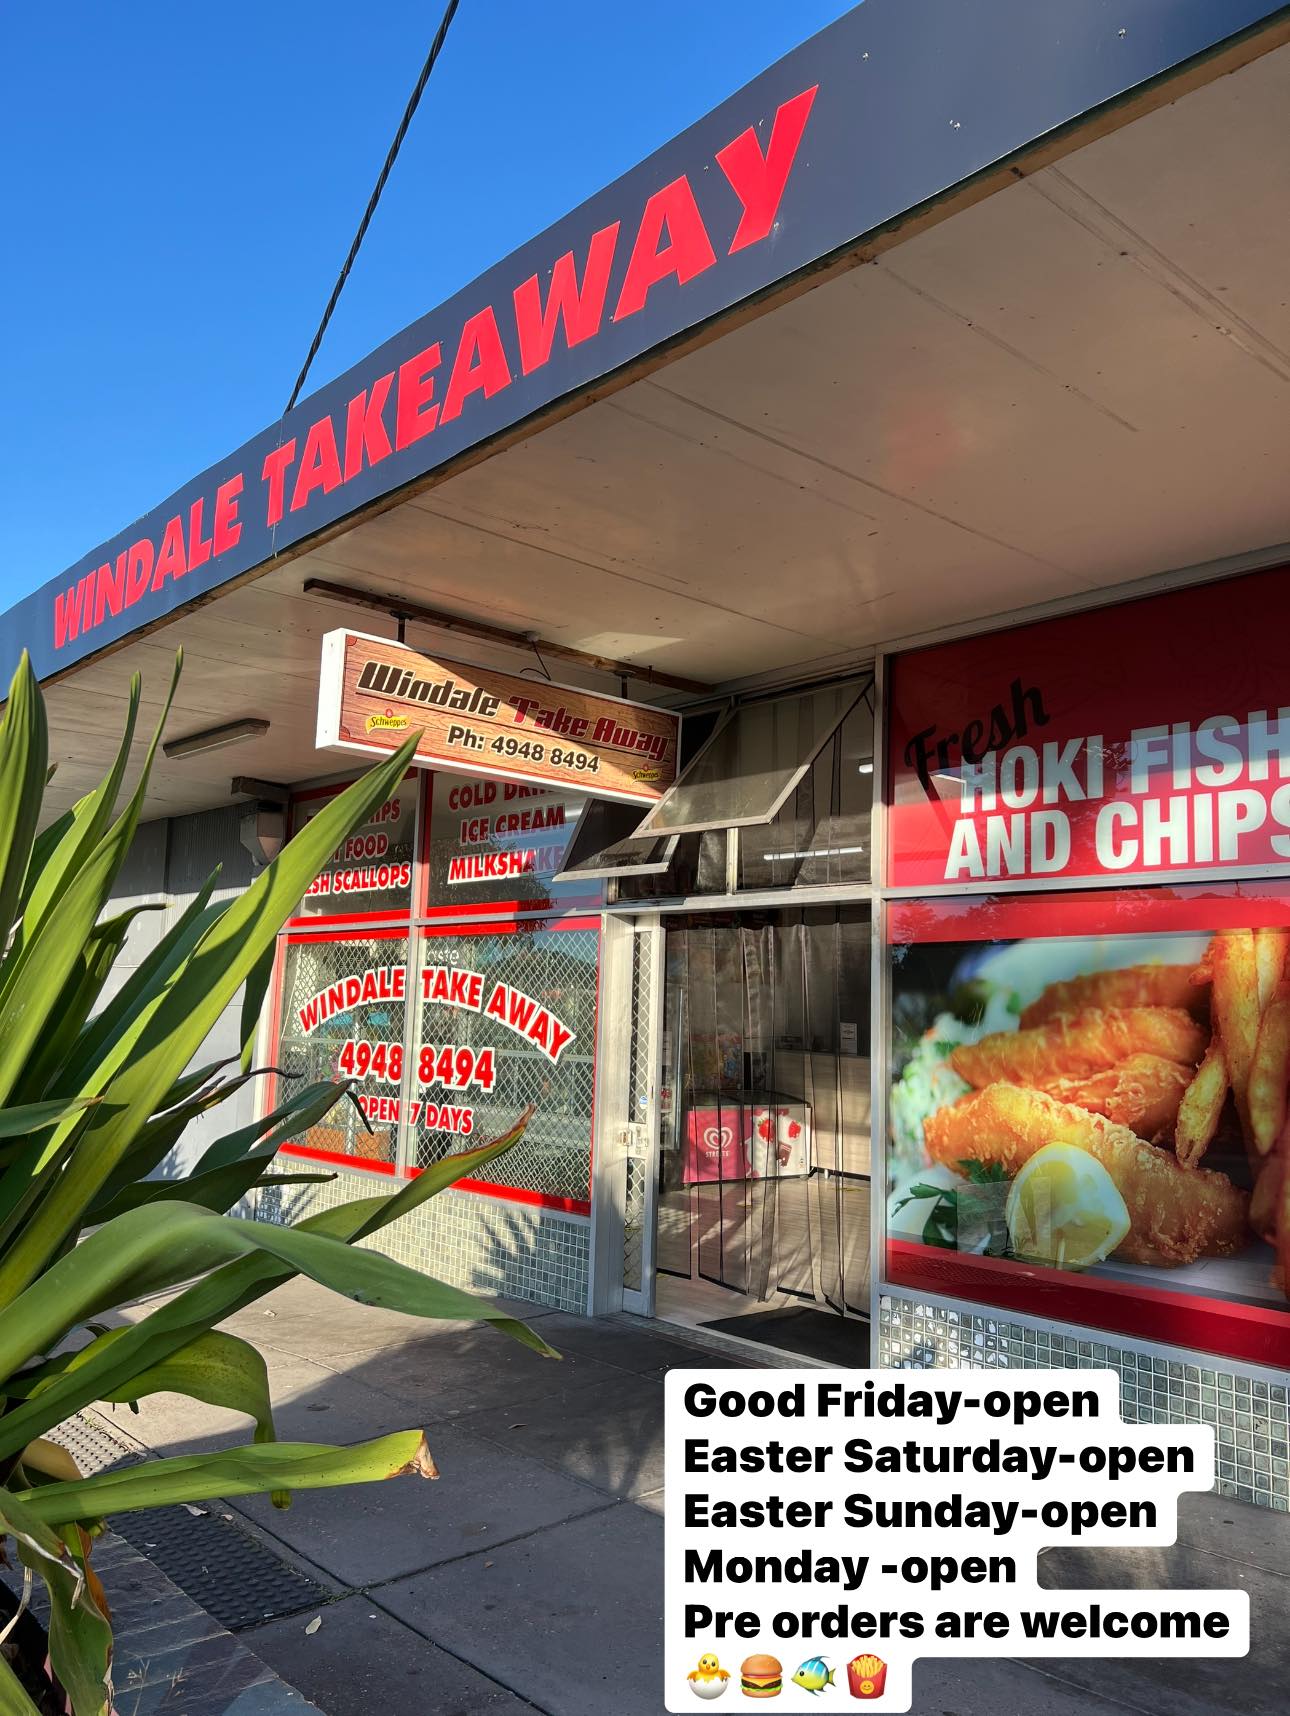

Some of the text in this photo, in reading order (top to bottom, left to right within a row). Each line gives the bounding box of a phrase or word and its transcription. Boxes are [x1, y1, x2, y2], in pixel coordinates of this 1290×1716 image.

[55, 85, 819, 648] WINDALE TAKEAWAY
[356, 661, 668, 761] Windale Take Away
[370, 717, 407, 728] Schweppes
[904, 677, 1050, 790] Fresh
[447, 724, 601, 773] Ph: 4948 8494
[960, 707, 1290, 814] HOKI FISH
[449, 782, 497, 810] COLD
[344, 833, 388, 861] FOOD
[460, 804, 565, 845] ICE CREAM
[944, 810, 1071, 879] AND
[333, 862, 411, 894] SCALLOPS
[298, 966, 577, 1064] WINDALE TAKE AWAY
[338, 1039, 496, 1092] 4948 8494
[357, 1095, 474, 1135] OPEN 7 DAYS
